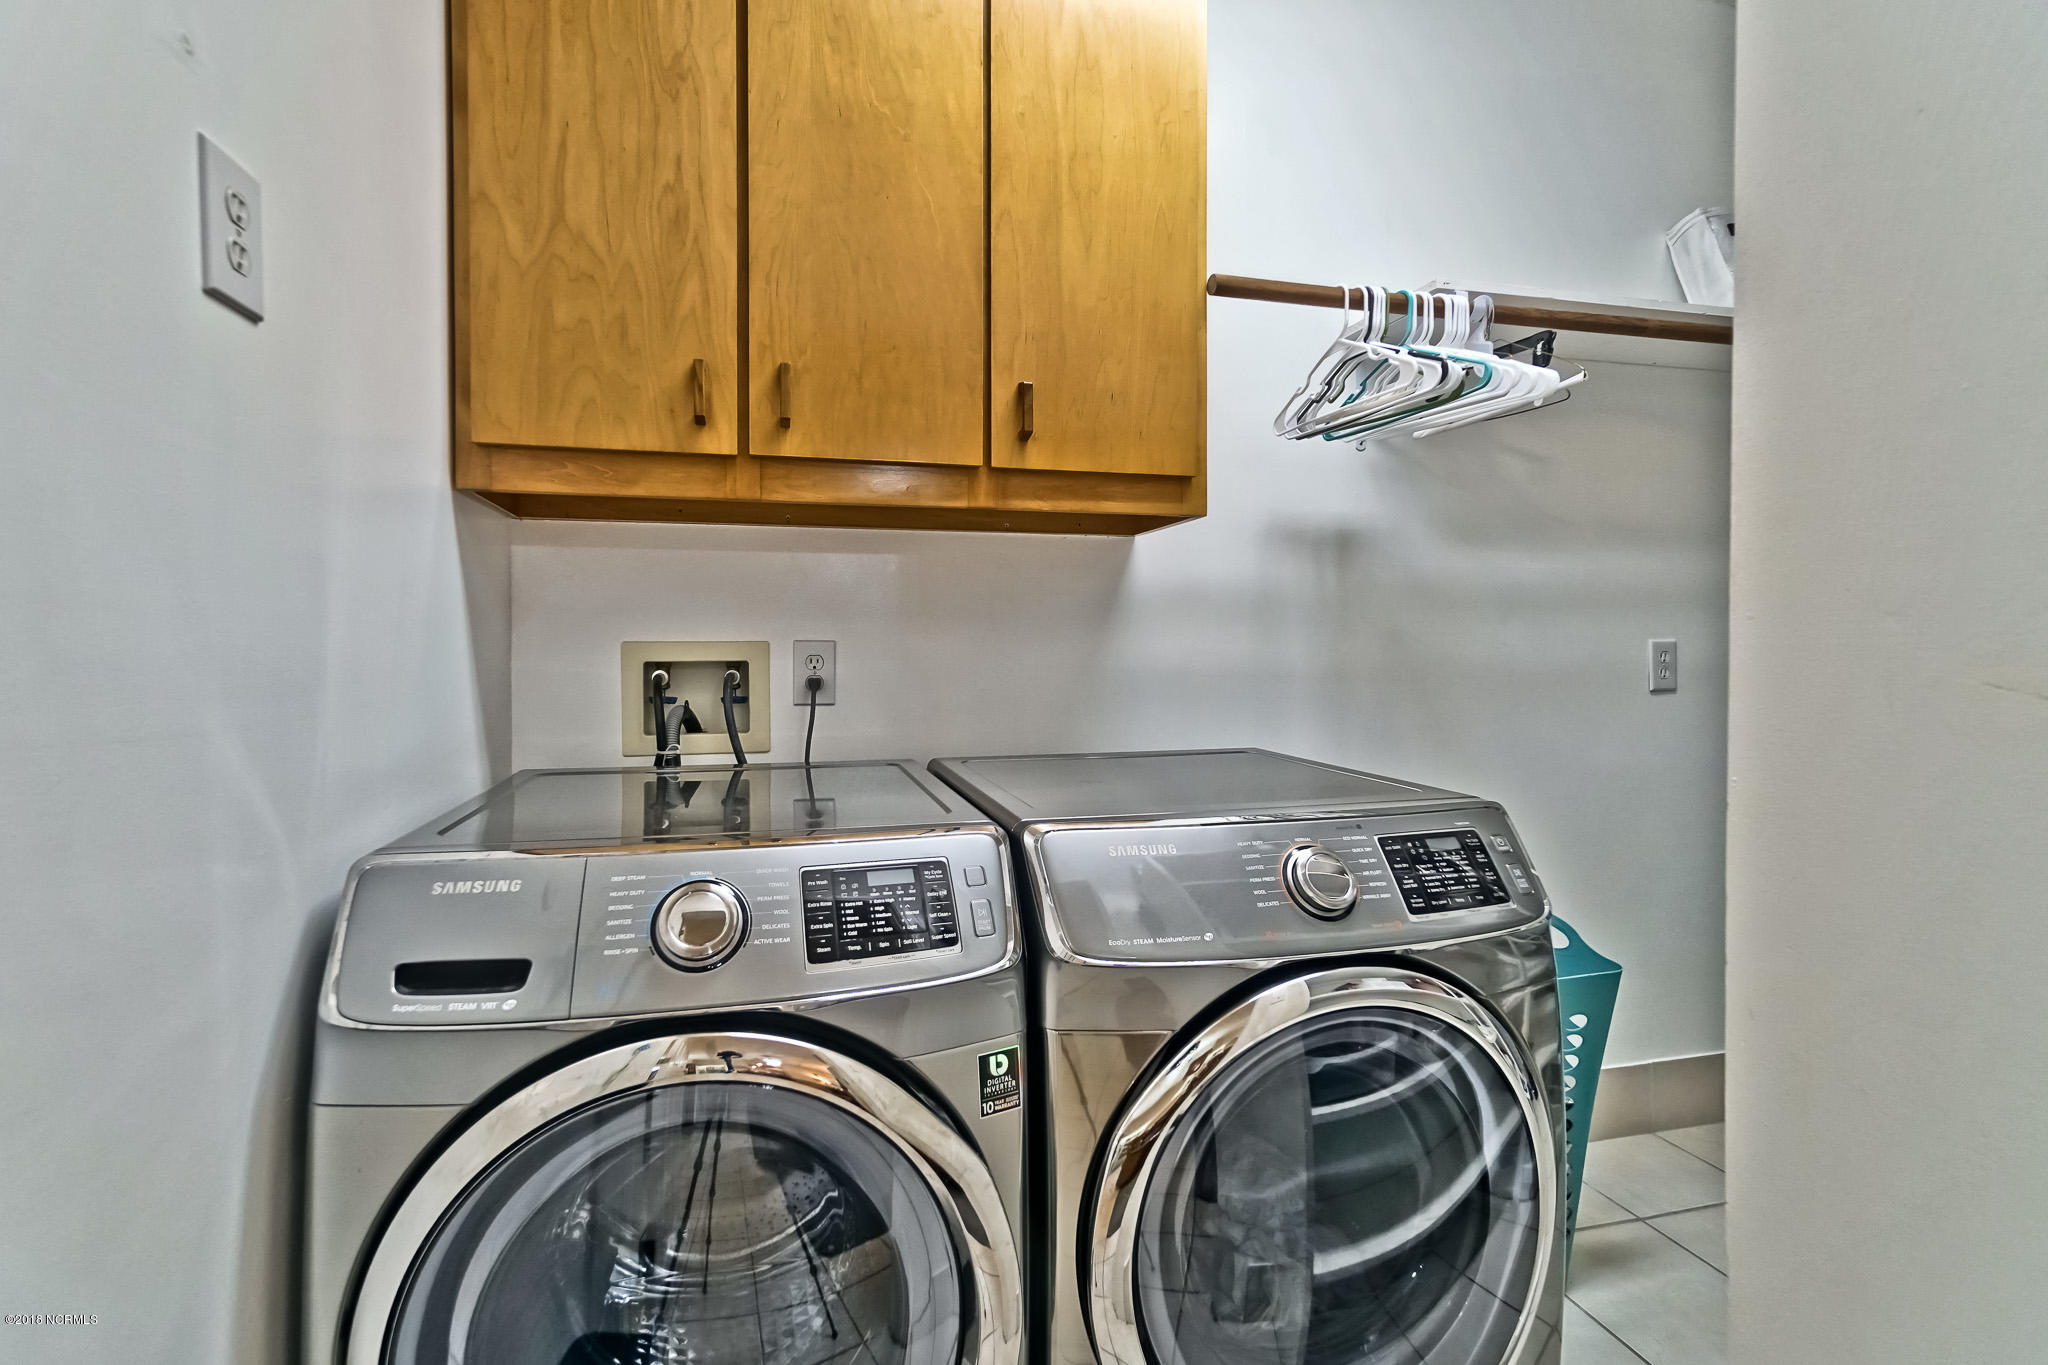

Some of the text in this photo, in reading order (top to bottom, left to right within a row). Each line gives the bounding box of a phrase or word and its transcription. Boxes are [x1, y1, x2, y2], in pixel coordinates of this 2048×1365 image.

[1109, 844, 1176, 856] SAMSUNG
[431, 880, 522, 895] SAMSUNG
[448, 1002, 477, 1011] STEAM
[987, 1074, 1012, 1086] DIGITAL
[984, 1080, 1016, 1094] INVERTER
[982, 1101, 994, 1115] 10
